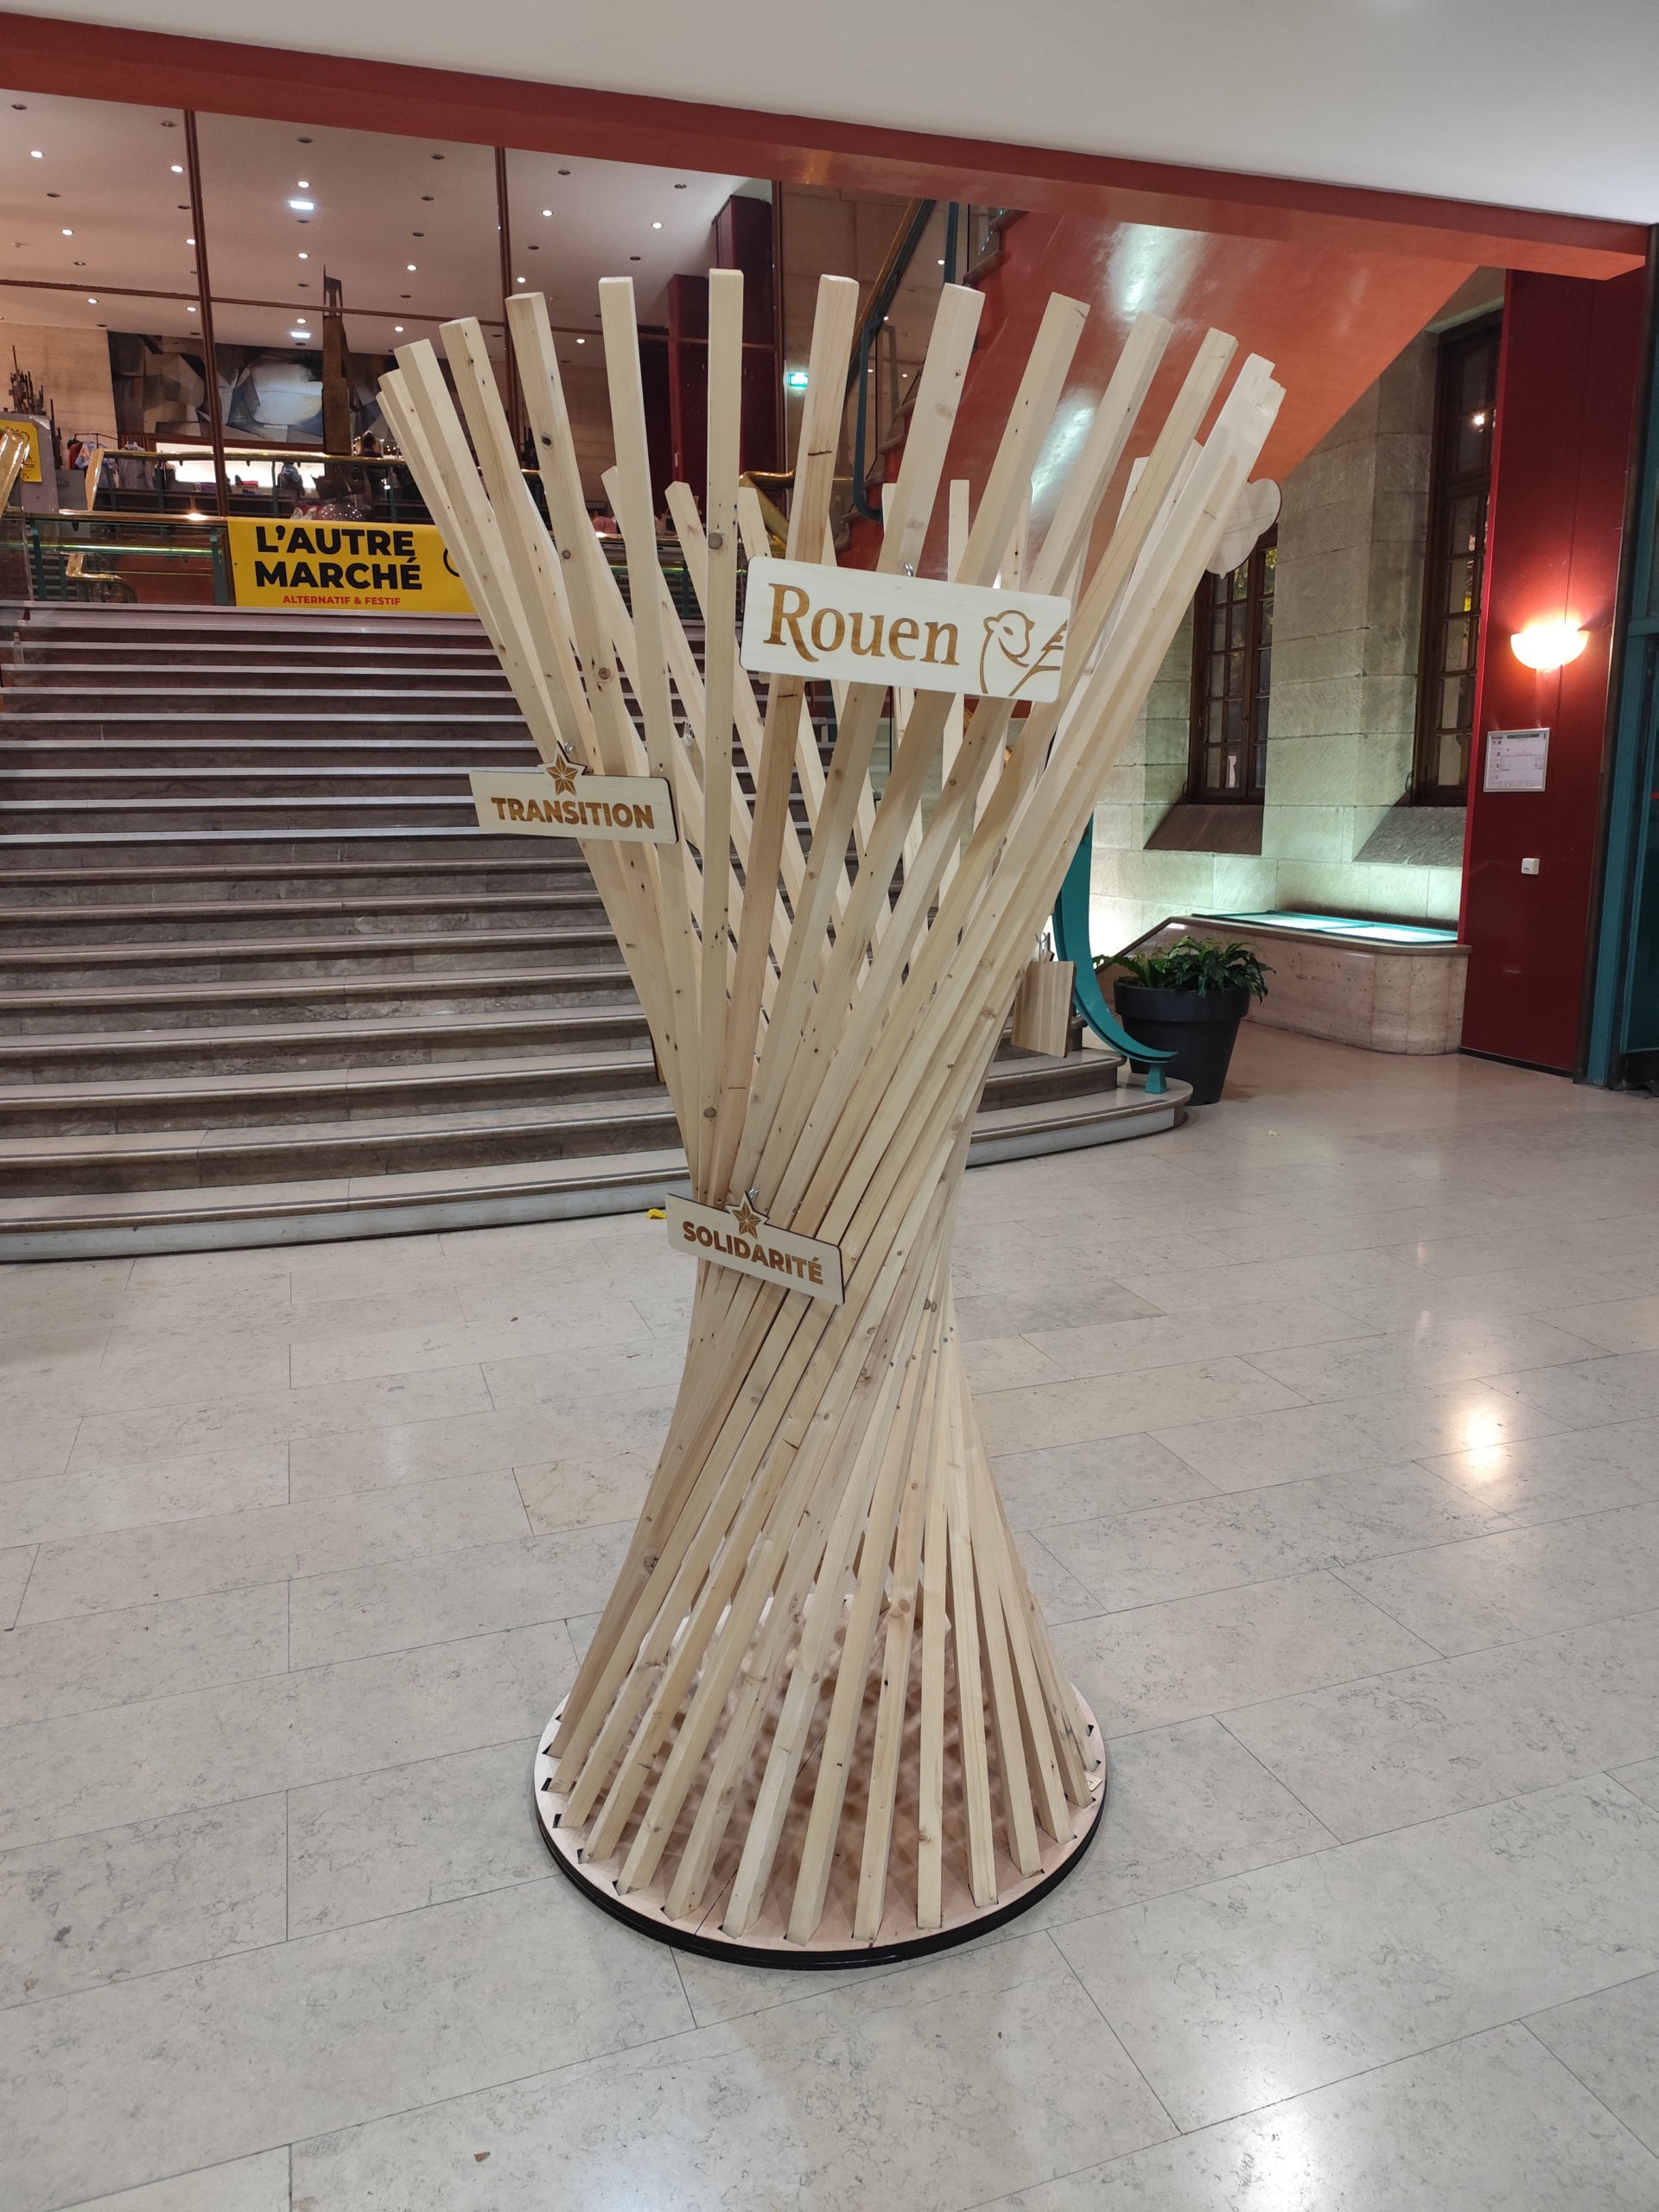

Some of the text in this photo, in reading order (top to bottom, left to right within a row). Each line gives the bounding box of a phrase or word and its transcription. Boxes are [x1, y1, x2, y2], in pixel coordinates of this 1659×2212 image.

[255, 557, 423, 590] MARCHÉ
[283, 595, 401, 606] ALTERNATIF & FESTIF
[763, 582, 960, 666] Rouen
[490, 797, 655, 830] TRANSITION
[682, 1220, 823, 1286] SOLIDARITÉ
